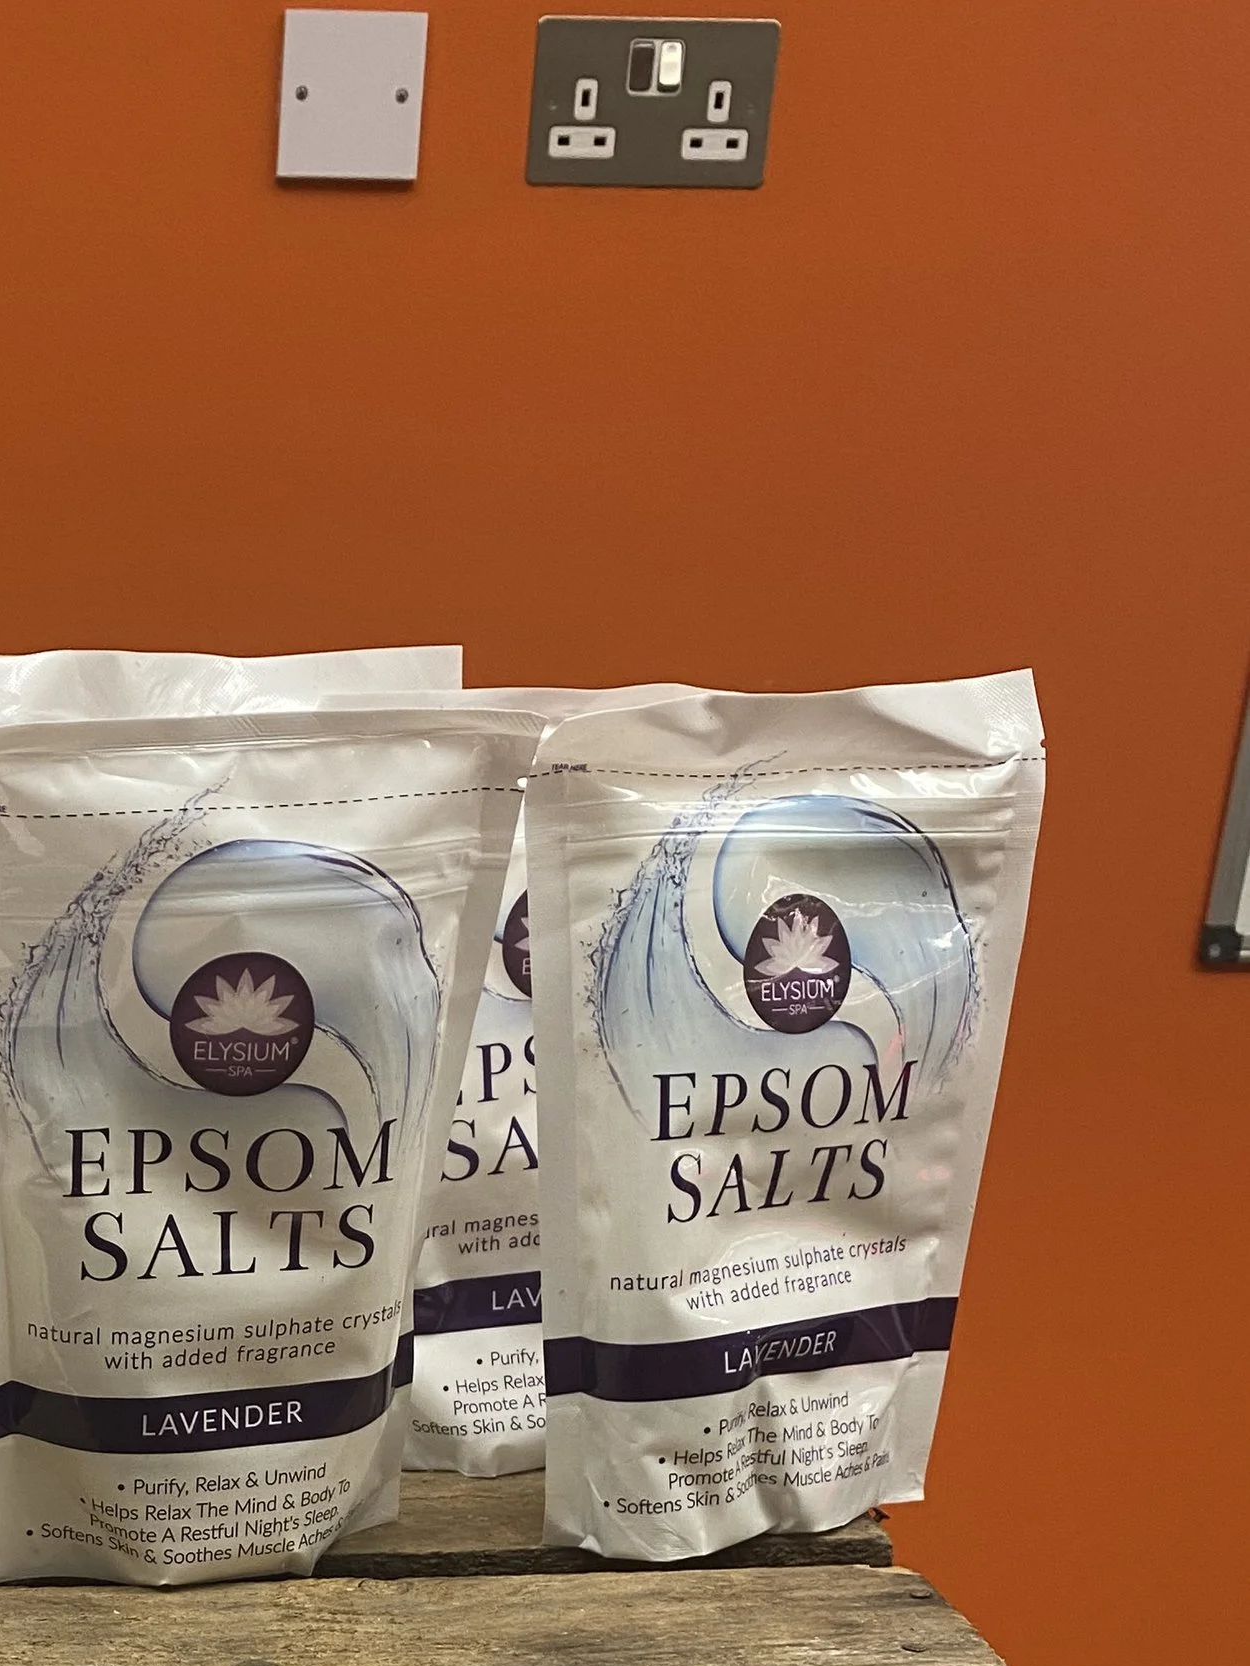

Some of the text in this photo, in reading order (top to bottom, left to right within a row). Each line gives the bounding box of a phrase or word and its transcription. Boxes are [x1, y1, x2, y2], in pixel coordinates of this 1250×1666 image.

[761, 978, 834, 1002] ELYSIUM
[789, 1003, 808, 1015] SPA
[194, 1040, 290, 1062] ELYSIUM
[228, 1064, 253, 1077] SPA
[650, 1060, 918, 1141] EPSOM
[63, 1118, 397, 1198] EPSOM
[667, 1139, 888, 1224] SALTS
[80, 1204, 375, 1282] SALTS
[458, 1235, 501, 1255] with
[610, 1236, 906, 1292] natural magnesium sulphate crystals
[686, 1268, 852, 1311] with added fragrance
[27, 1300, 402, 1349] natural magnesium sulphate crystals
[105, 1339, 336, 1370] with added fragrance
[490, 1348, 539, 1366] Purify,
[724, 1330, 837, 1374] LAVENDER
[455, 1373, 545, 1395] Helps Relax
[453, 1394, 535, 1415] Promote A
[789, 1391, 849, 1413] & Unwind
[141, 1400, 303, 1437] LAVENDER
[674, 1448, 723, 1469] Helps
[133, 1463, 327, 1499] Purify, Relax & Unwind
